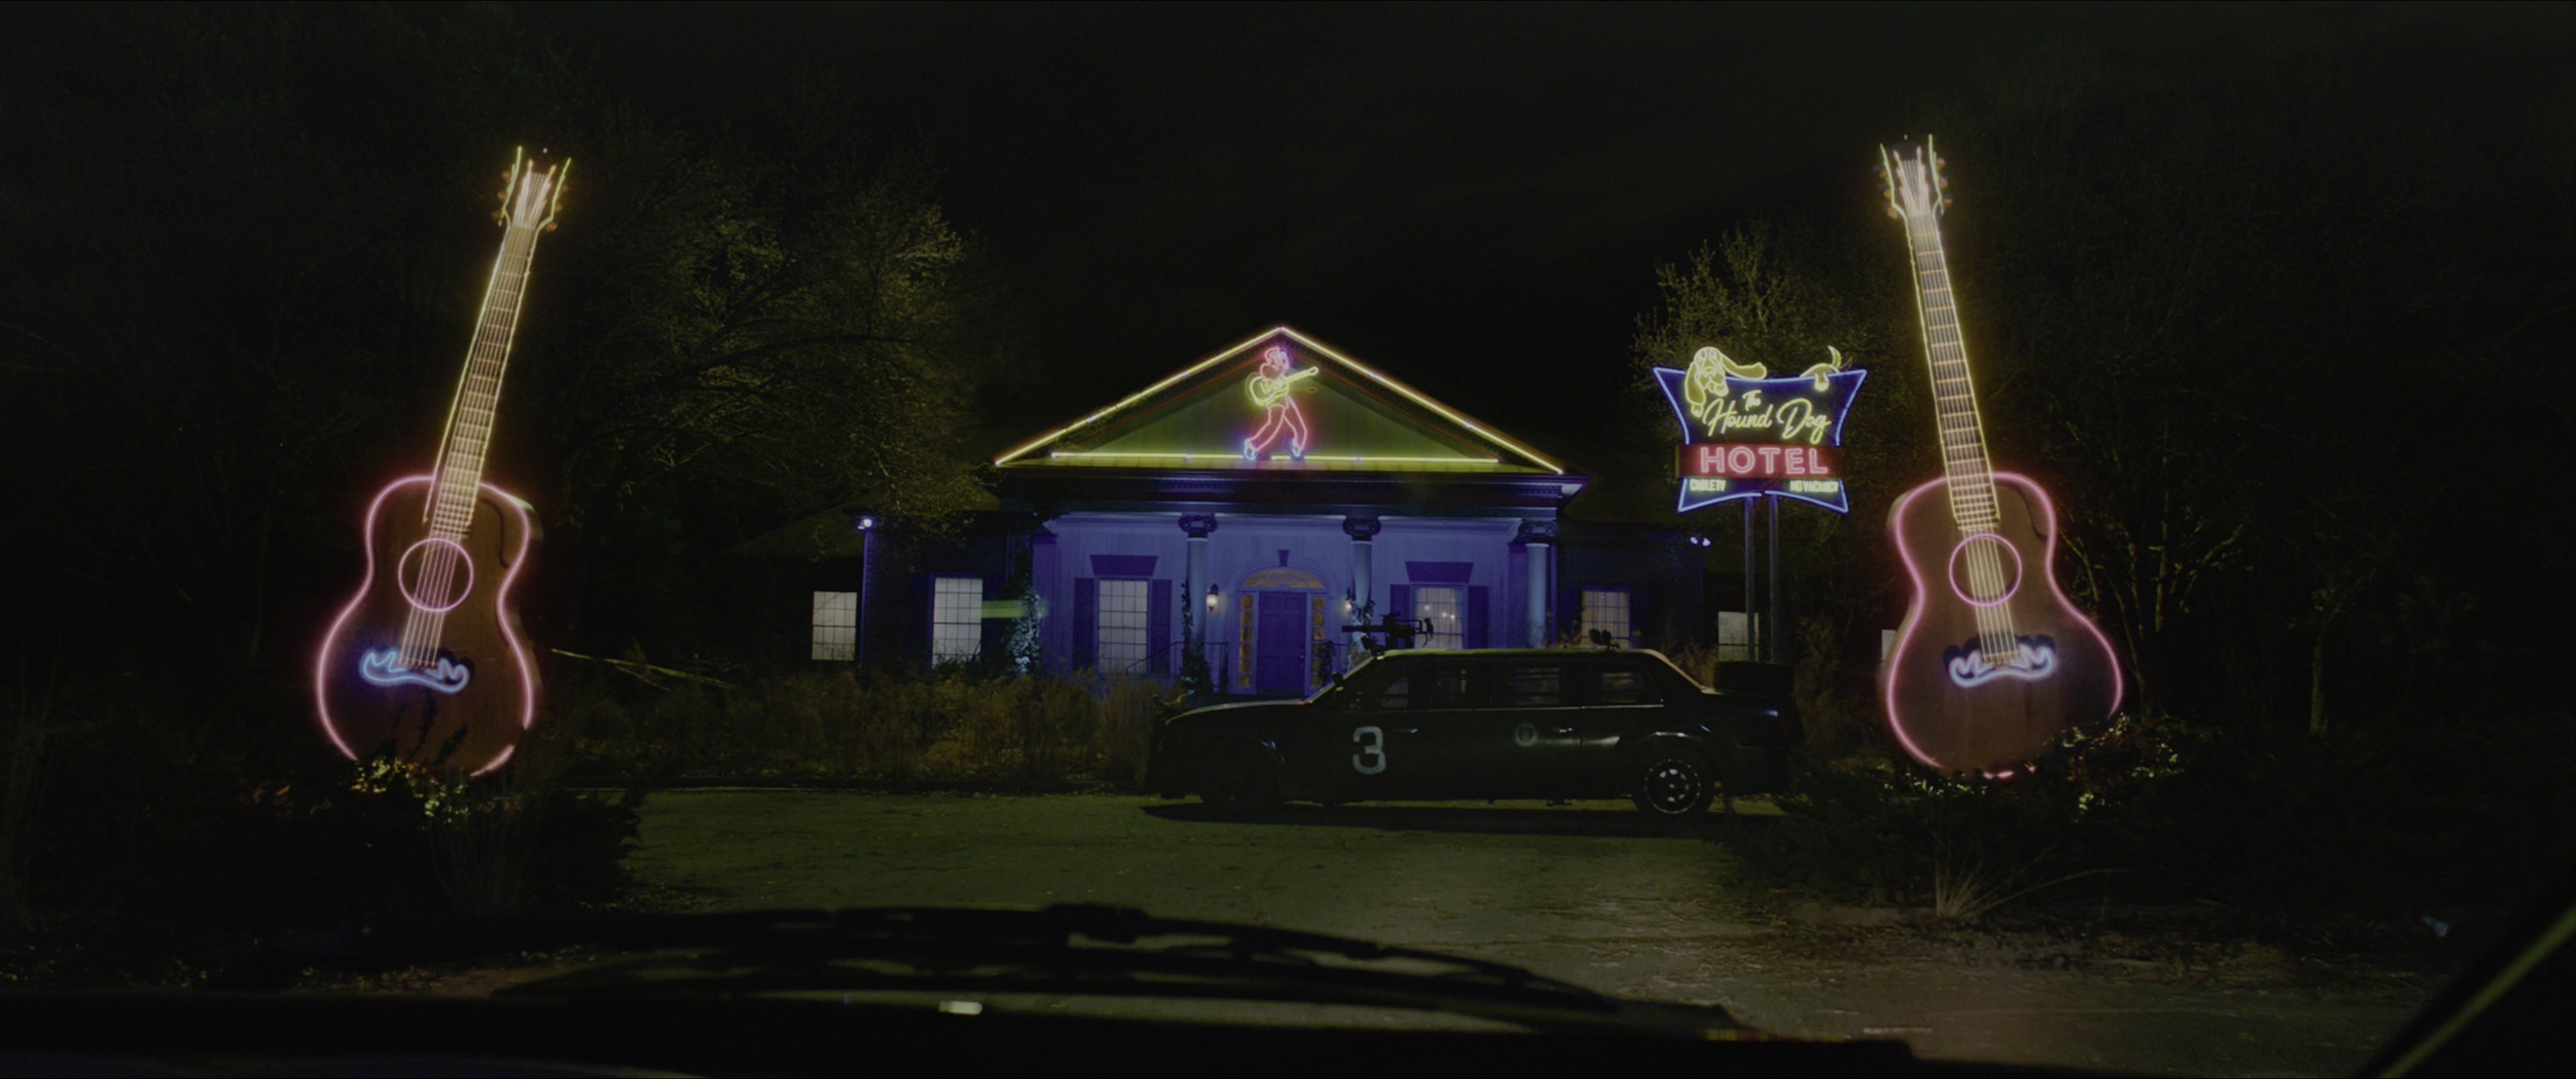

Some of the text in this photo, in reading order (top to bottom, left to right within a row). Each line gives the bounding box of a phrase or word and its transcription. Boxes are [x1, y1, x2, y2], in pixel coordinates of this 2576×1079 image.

[1742, 389, 1762, 411] The
[1702, 397, 1831, 445] Hound Dog
[1700, 446, 1829, 475] HOTEL
[1352, 725, 1387, 774] 3
